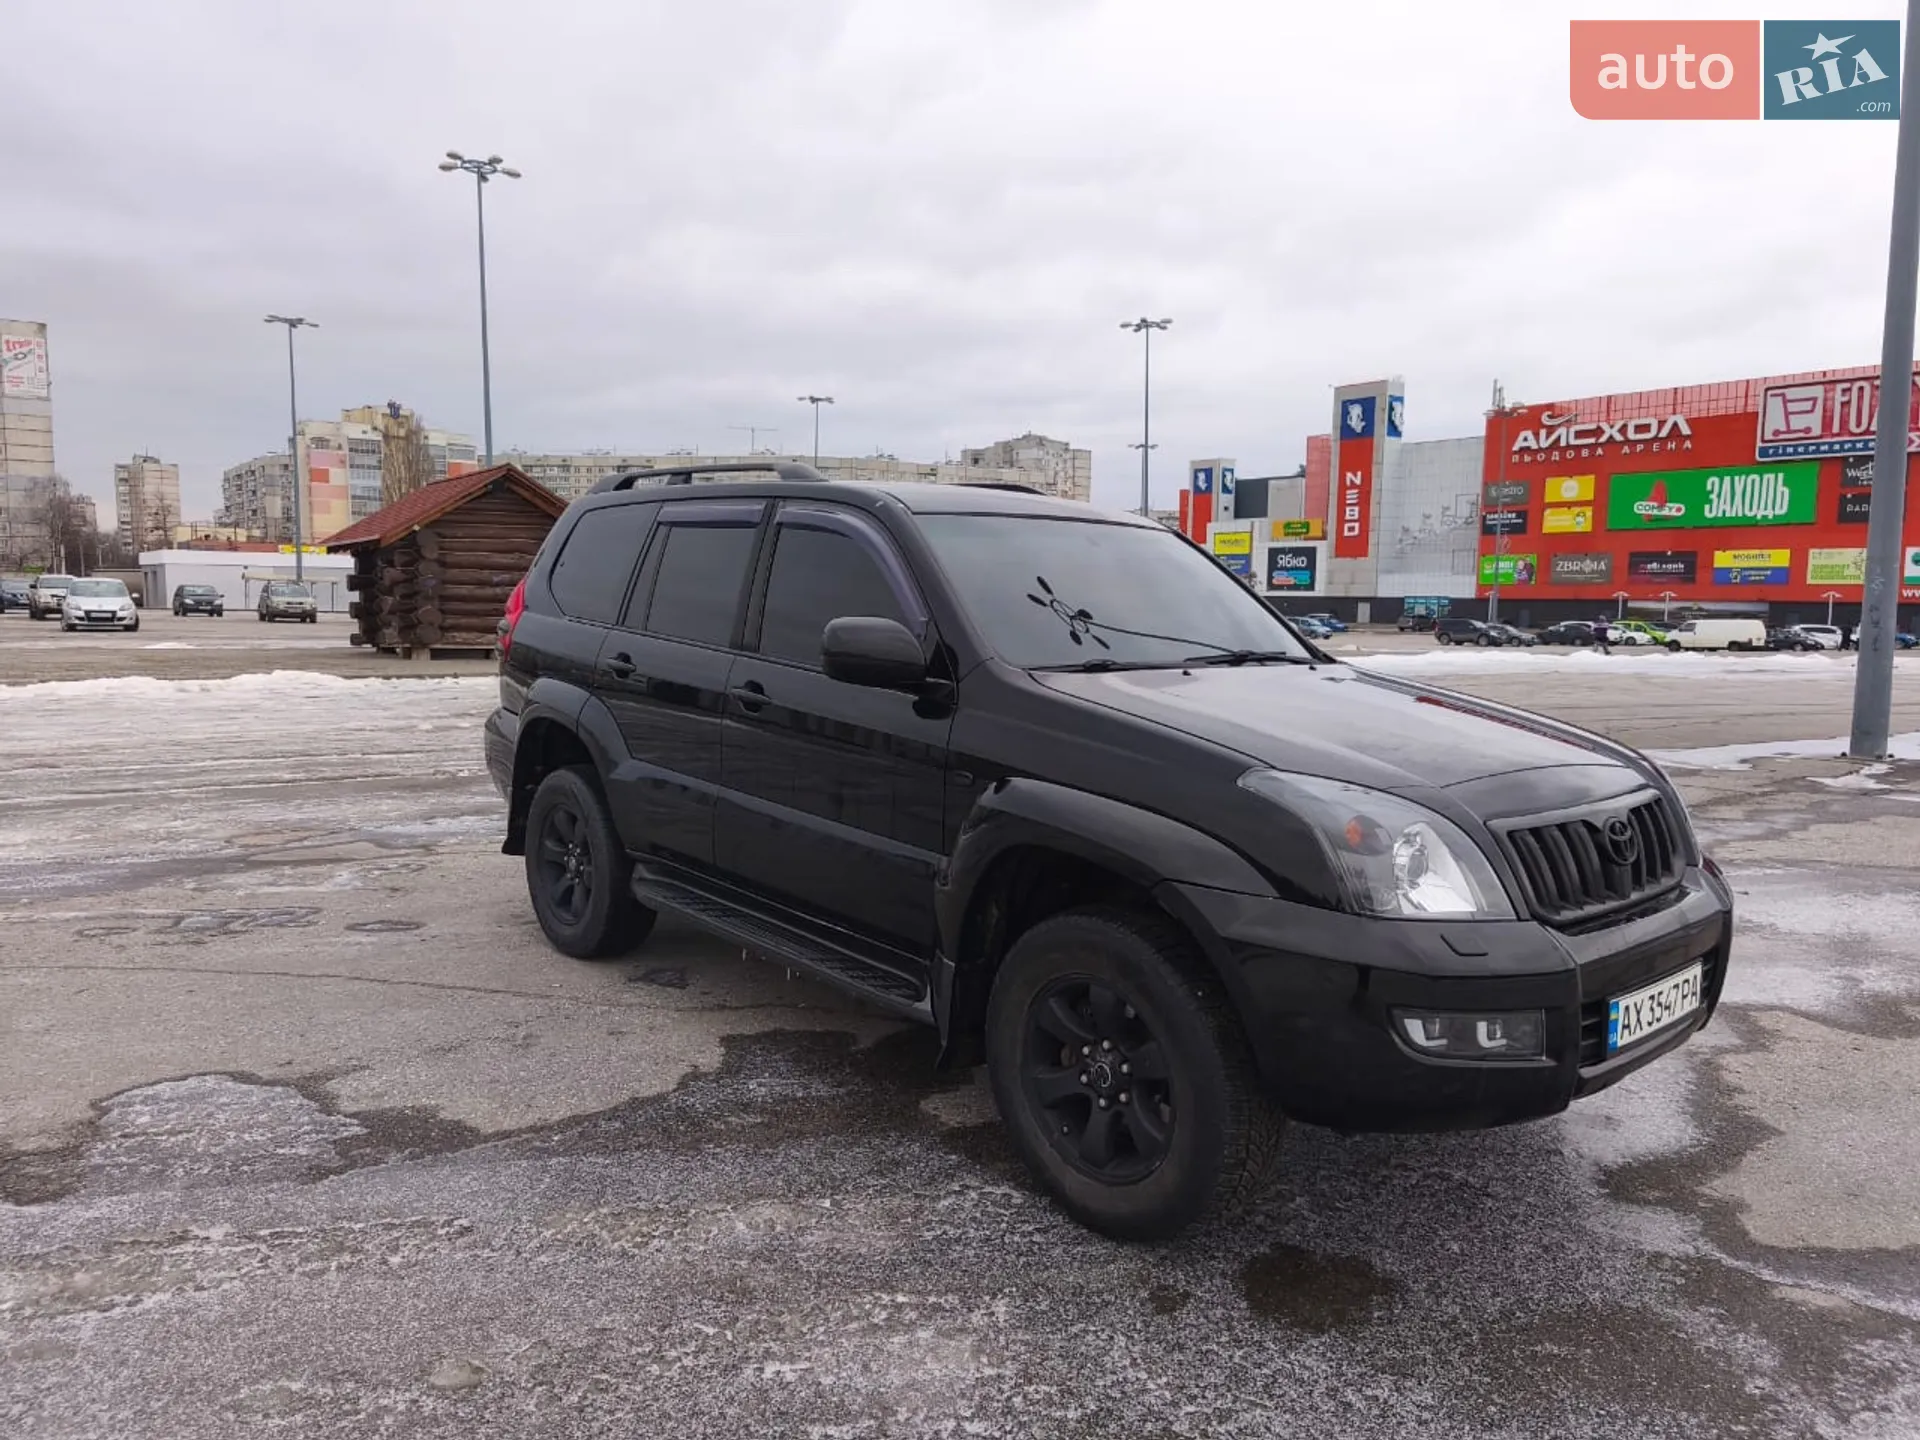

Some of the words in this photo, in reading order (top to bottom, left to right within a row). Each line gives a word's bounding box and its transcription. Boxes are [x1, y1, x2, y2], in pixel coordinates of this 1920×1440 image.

[1512, 411, 1692, 451] АЙСХОЛ
[1621, 440, 1692, 455] АРЕНА
[1768, 442, 1876, 455] гіпермарке
[1704, 473, 1790, 519] ЗАХОДЬ
[1635, 503, 1677, 516] COMFY
[1277, 553, 1307, 567] Ябко
[1620, 999, 1643, 1040] AX
[1647, 983, 1680, 1027] 3547
[1681, 974, 1698, 1012] PA
